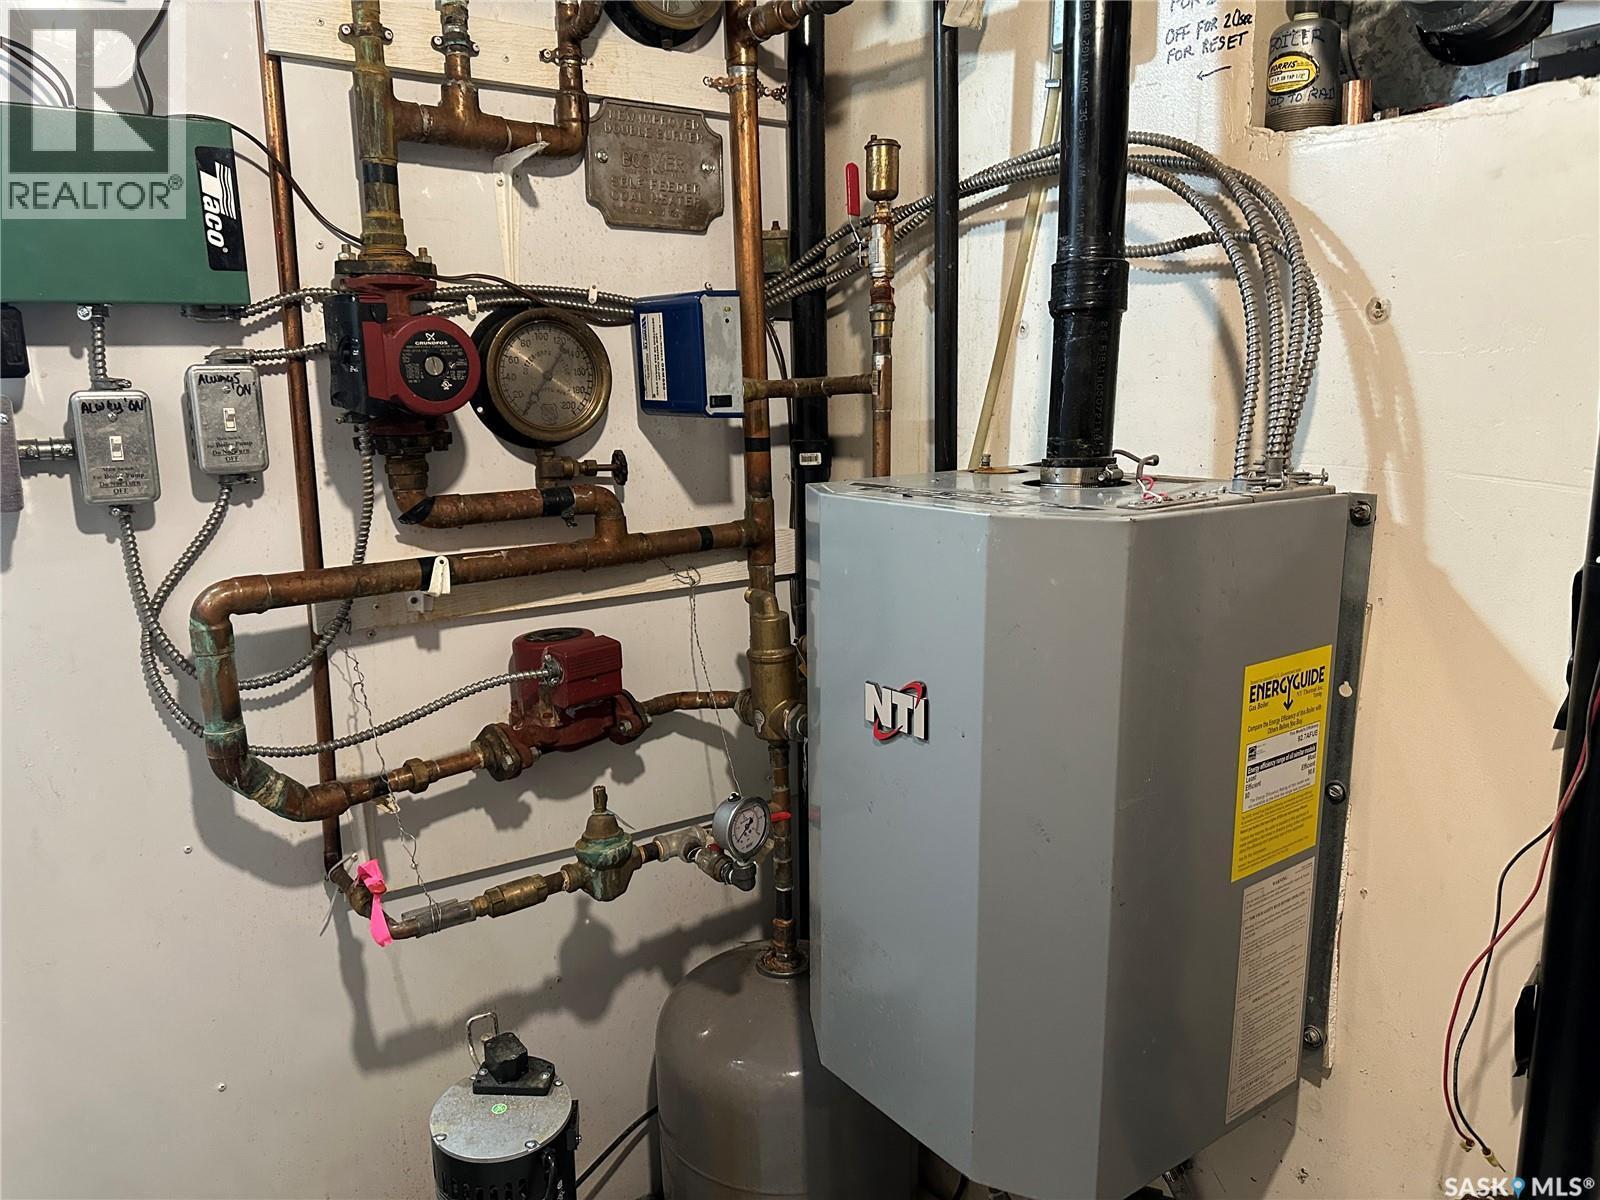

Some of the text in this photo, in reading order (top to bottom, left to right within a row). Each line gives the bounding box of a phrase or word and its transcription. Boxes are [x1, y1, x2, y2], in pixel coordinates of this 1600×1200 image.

[1165, 23, 1191, 45] OFF
[1196, 16, 1218, 40] FOR
[1167, 30, 1249, 64] FOR RESET
[1288, 93, 1303, 103] TO
[650, 180, 701, 195] FEEDER
[1249, 665, 1326, 704] ENERGYGUIDE
[1257, 701, 1269, 710] Boiler
